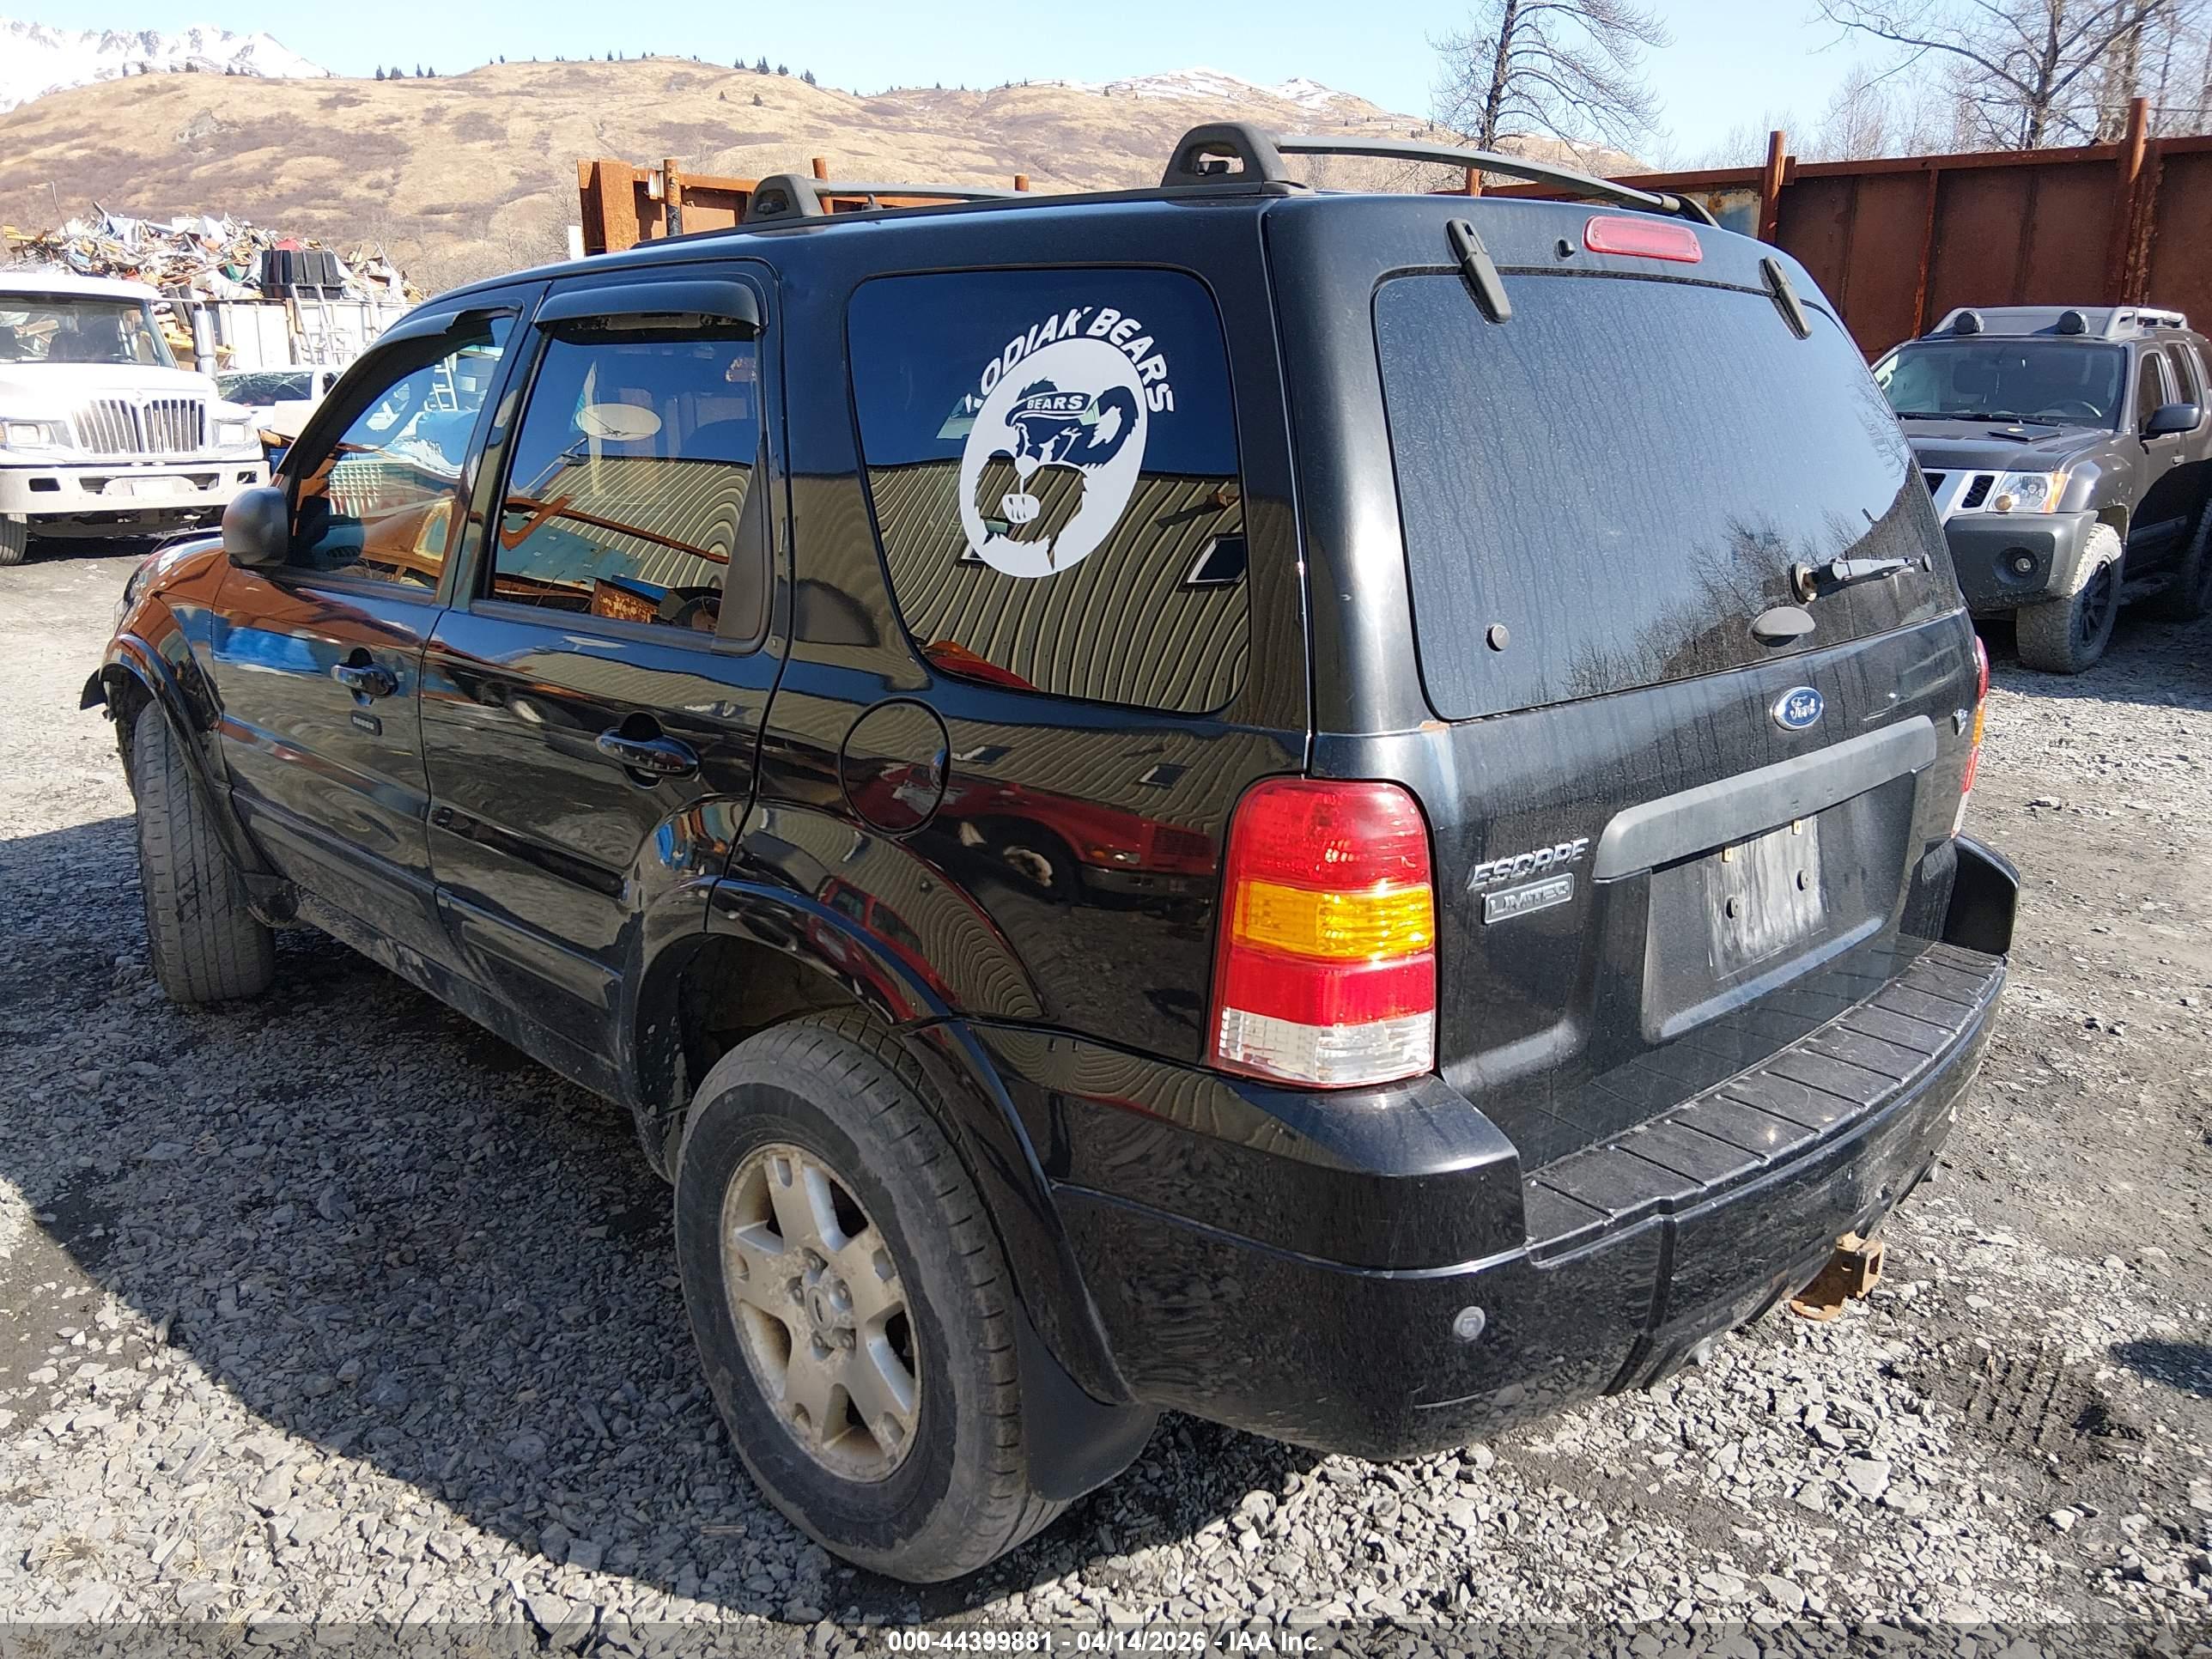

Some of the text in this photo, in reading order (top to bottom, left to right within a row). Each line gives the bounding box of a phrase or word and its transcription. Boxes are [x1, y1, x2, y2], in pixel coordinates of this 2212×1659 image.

[1085, 307, 1175, 413] BEARS
[1026, 394, 1085, 410] BEARS
[1790, 695, 1817, 720] Ford
[1466, 836, 1589, 891] ESCAPE
[1489, 879, 1570, 915] LIMITED
